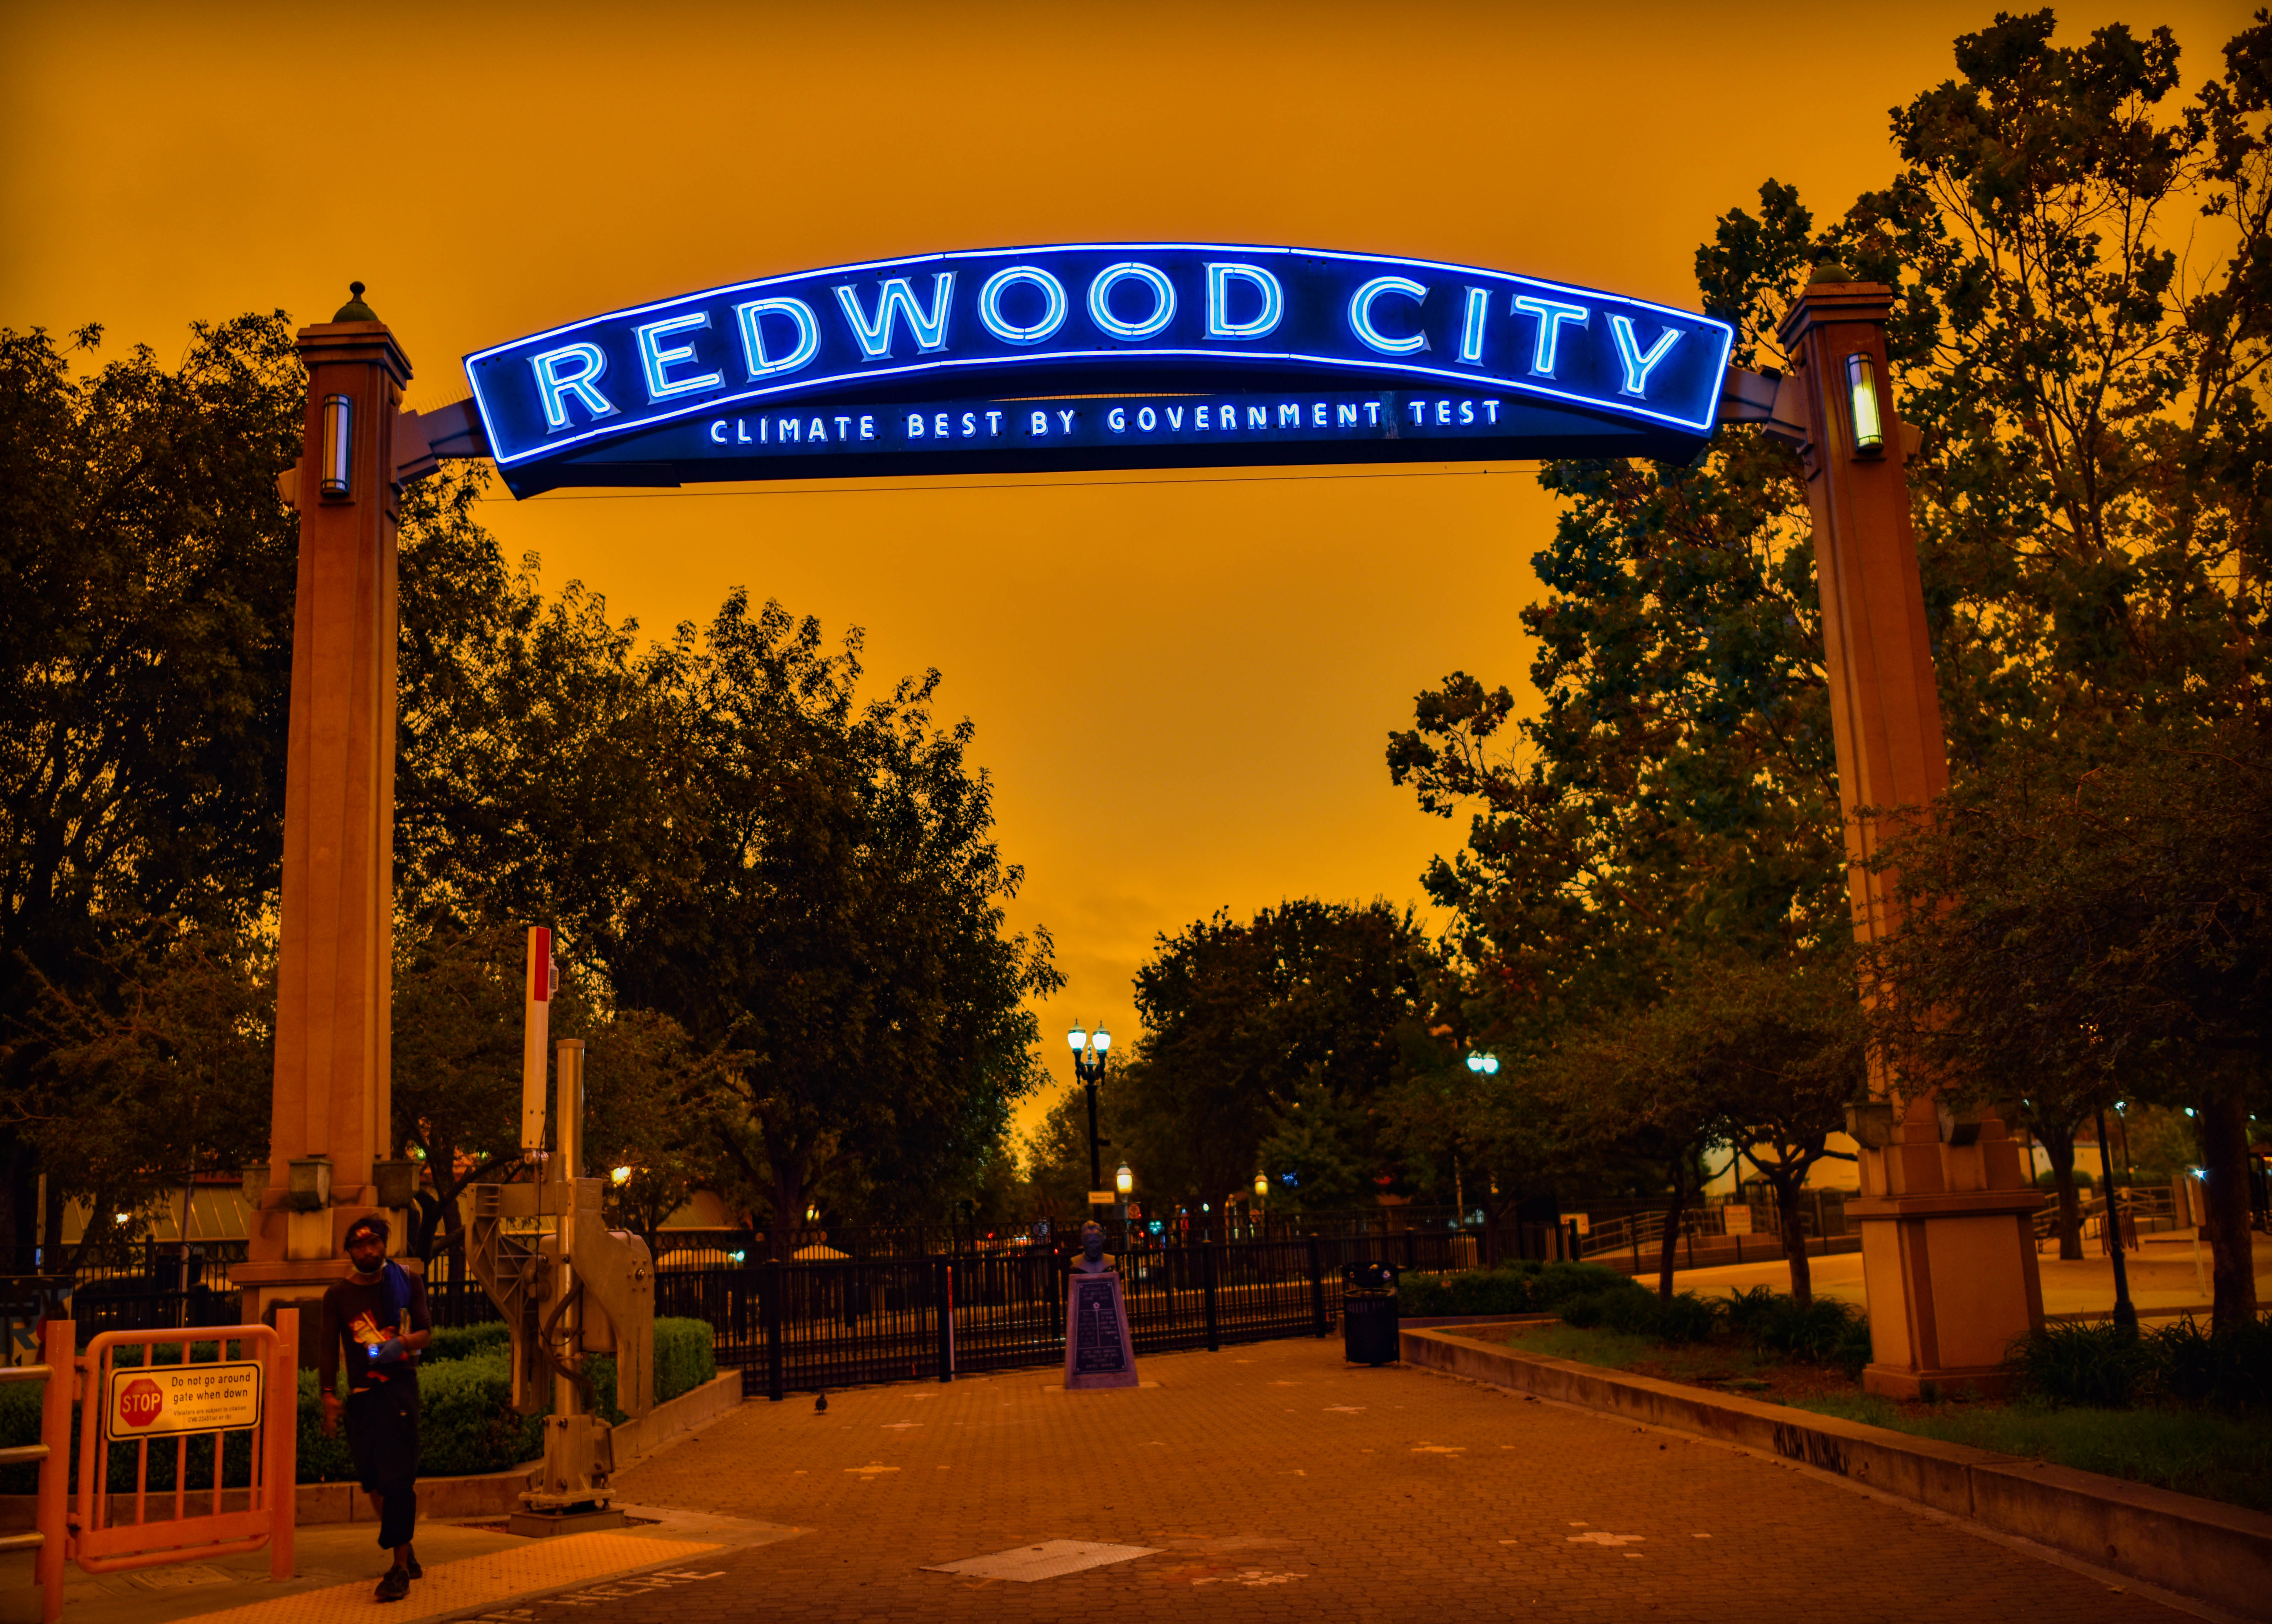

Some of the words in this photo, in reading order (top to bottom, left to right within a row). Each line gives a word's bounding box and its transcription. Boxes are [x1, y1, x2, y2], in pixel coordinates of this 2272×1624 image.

[526, 261, 1284, 435] REDWOOD
[1347, 276, 1687, 400] CITY
[711, 415, 875, 444] CLIMATE
[907, 411, 1003, 439] BEST
[1031, 409, 1076, 437] BY
[1107, 401, 1381, 433] GOVERNMENT
[1408, 400, 1501, 427] TEST
[171, 1377, 183, 1386] Do
[187, 1375, 201, 1386] not
[204, 1377, 215, 1387] go
[218, 1372, 250, 1384] around
[122, 1393, 160, 1413] STOP
[174, 1392, 193, 1405] gate
[197, 1390, 220, 1400] when
[224, 1388, 248, 1398] down
[536, 1567, 727, 1606] HERE
